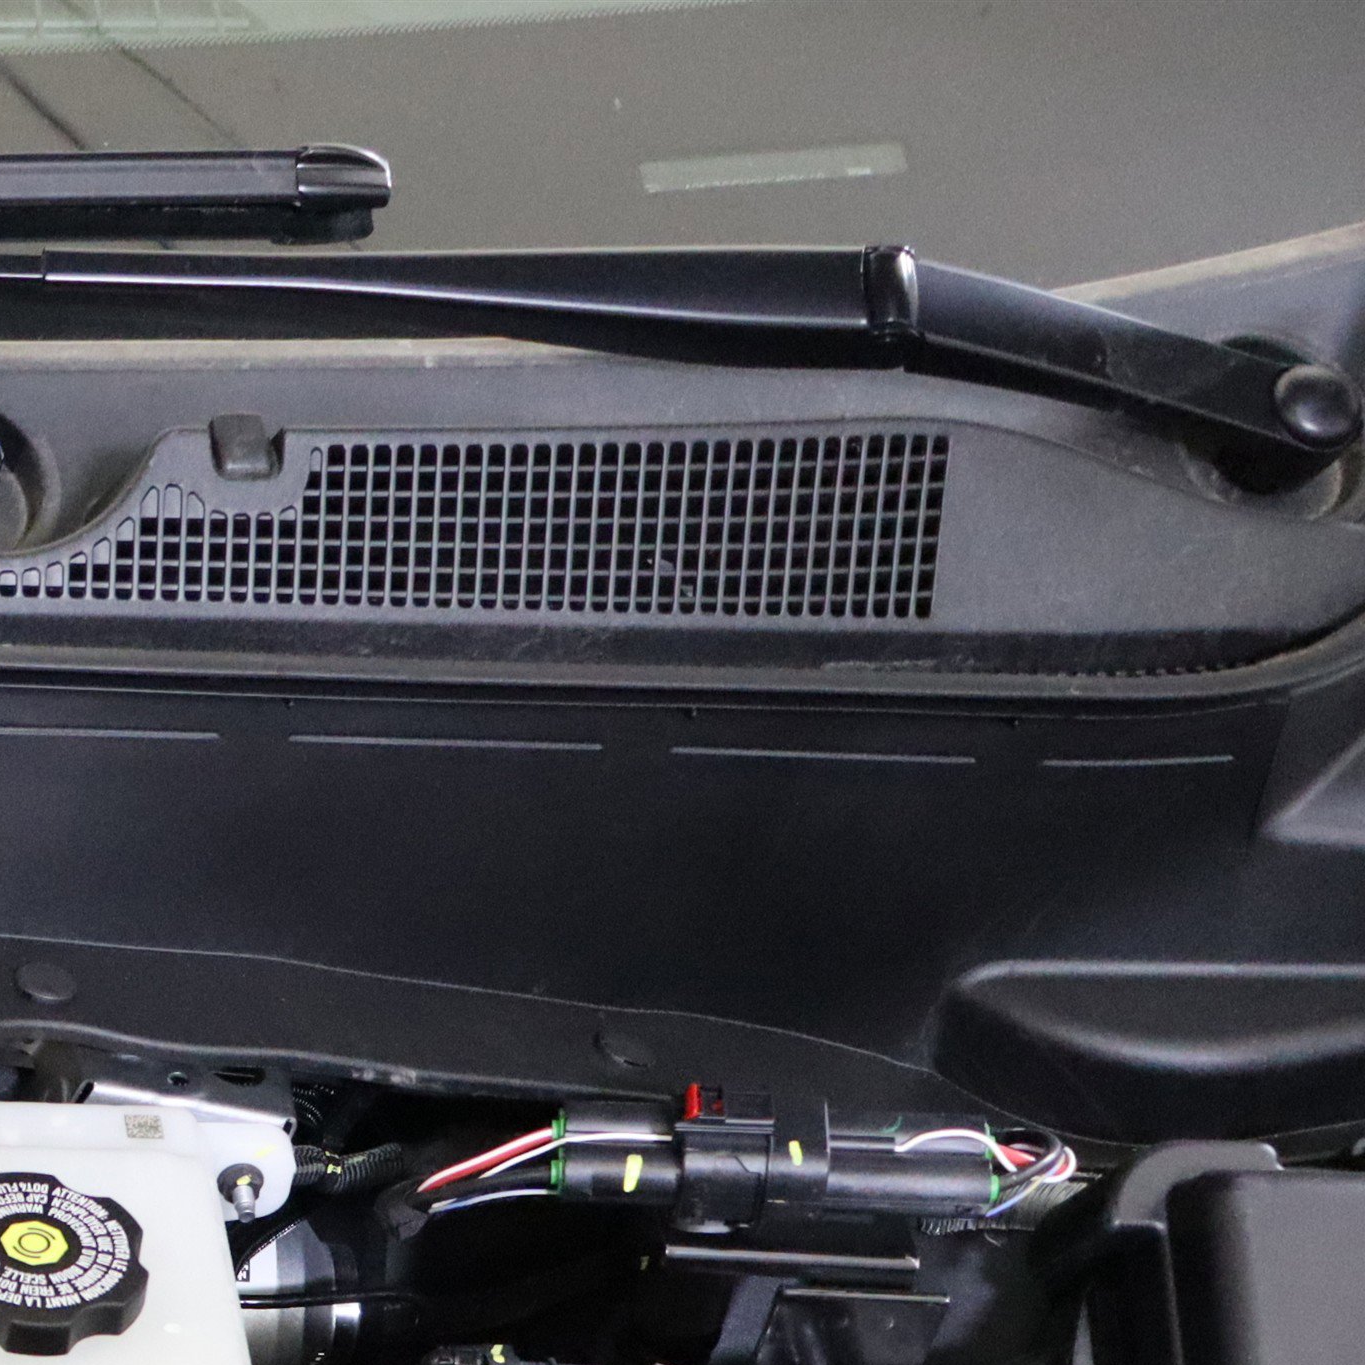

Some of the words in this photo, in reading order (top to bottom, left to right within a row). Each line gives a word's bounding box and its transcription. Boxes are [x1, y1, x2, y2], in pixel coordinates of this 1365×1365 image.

[18, 1181, 49, 1194] DOT4
[25, 1194, 48, 1206] CAP
[20, 1283, 54, 1297] FREIN
[56, 1283, 73, 1295] DE
[24, 1296, 41, 1308] LA
[45, 1292, 81, 1309] AVANT
